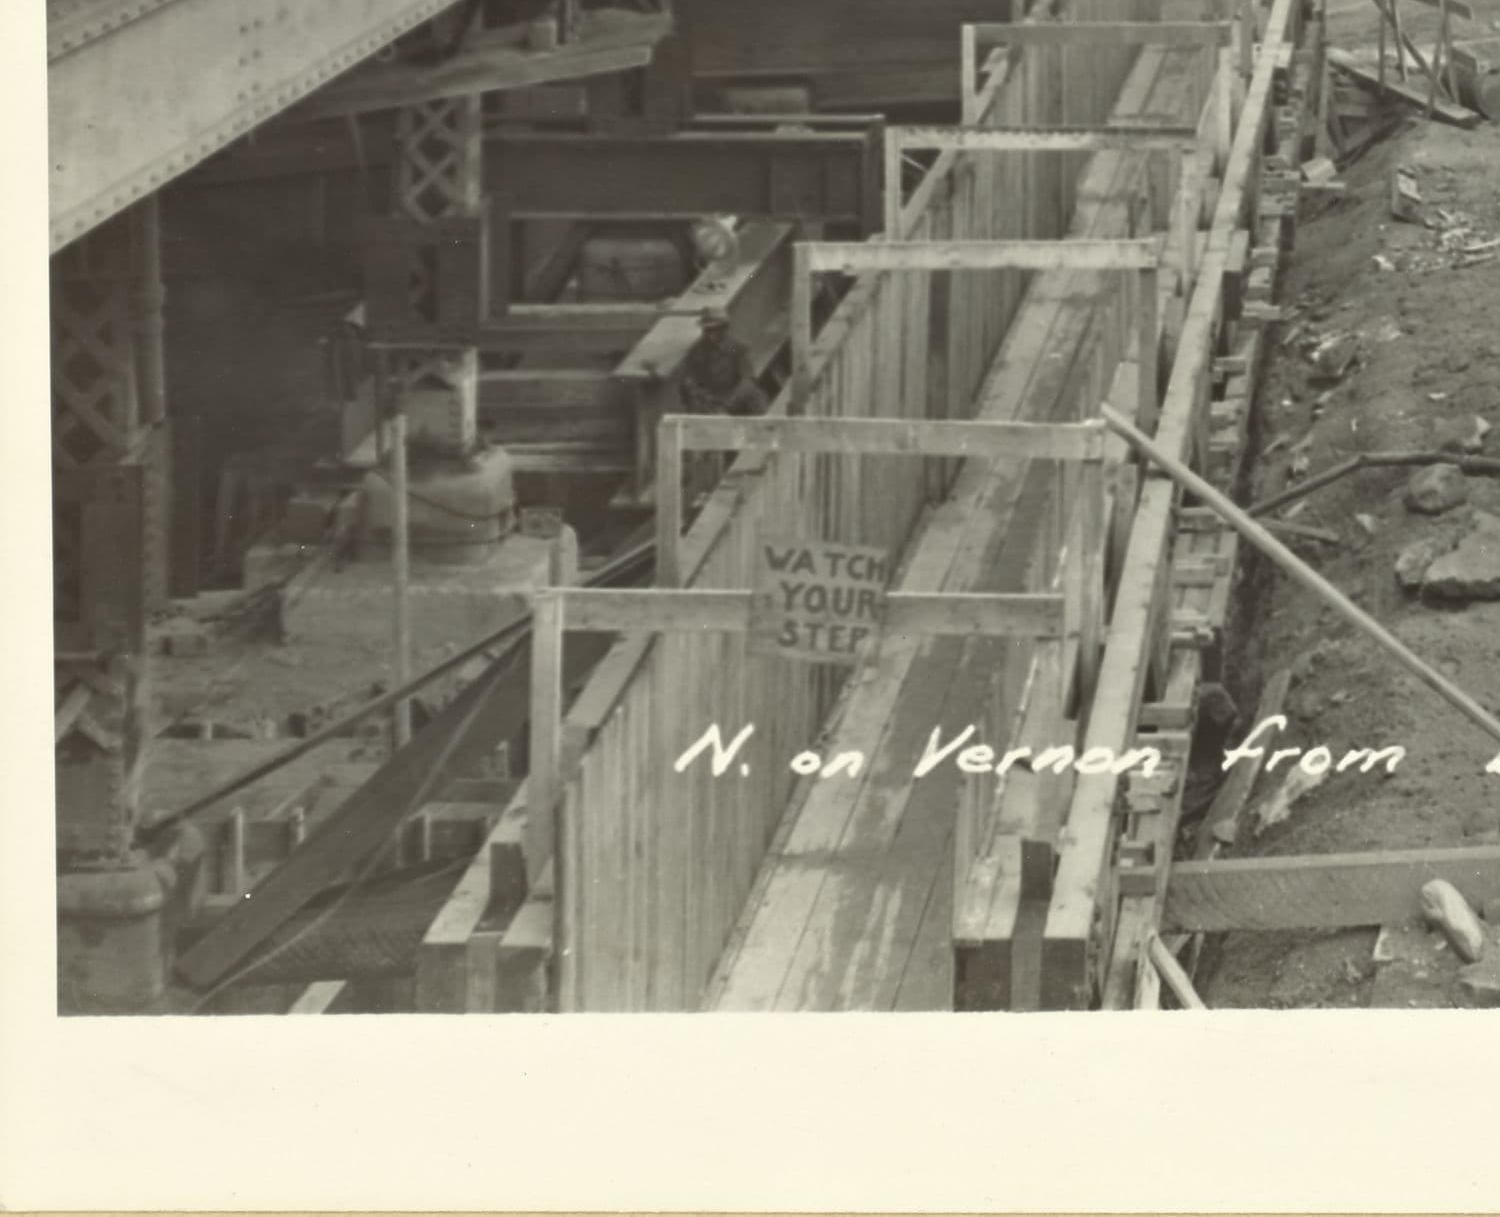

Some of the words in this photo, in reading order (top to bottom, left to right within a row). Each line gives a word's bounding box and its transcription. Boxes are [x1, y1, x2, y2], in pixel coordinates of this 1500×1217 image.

[764, 545, 886, 582] WATCH
[780, 580, 878, 620] YOUR
[776, 619, 869, 654] STEP
